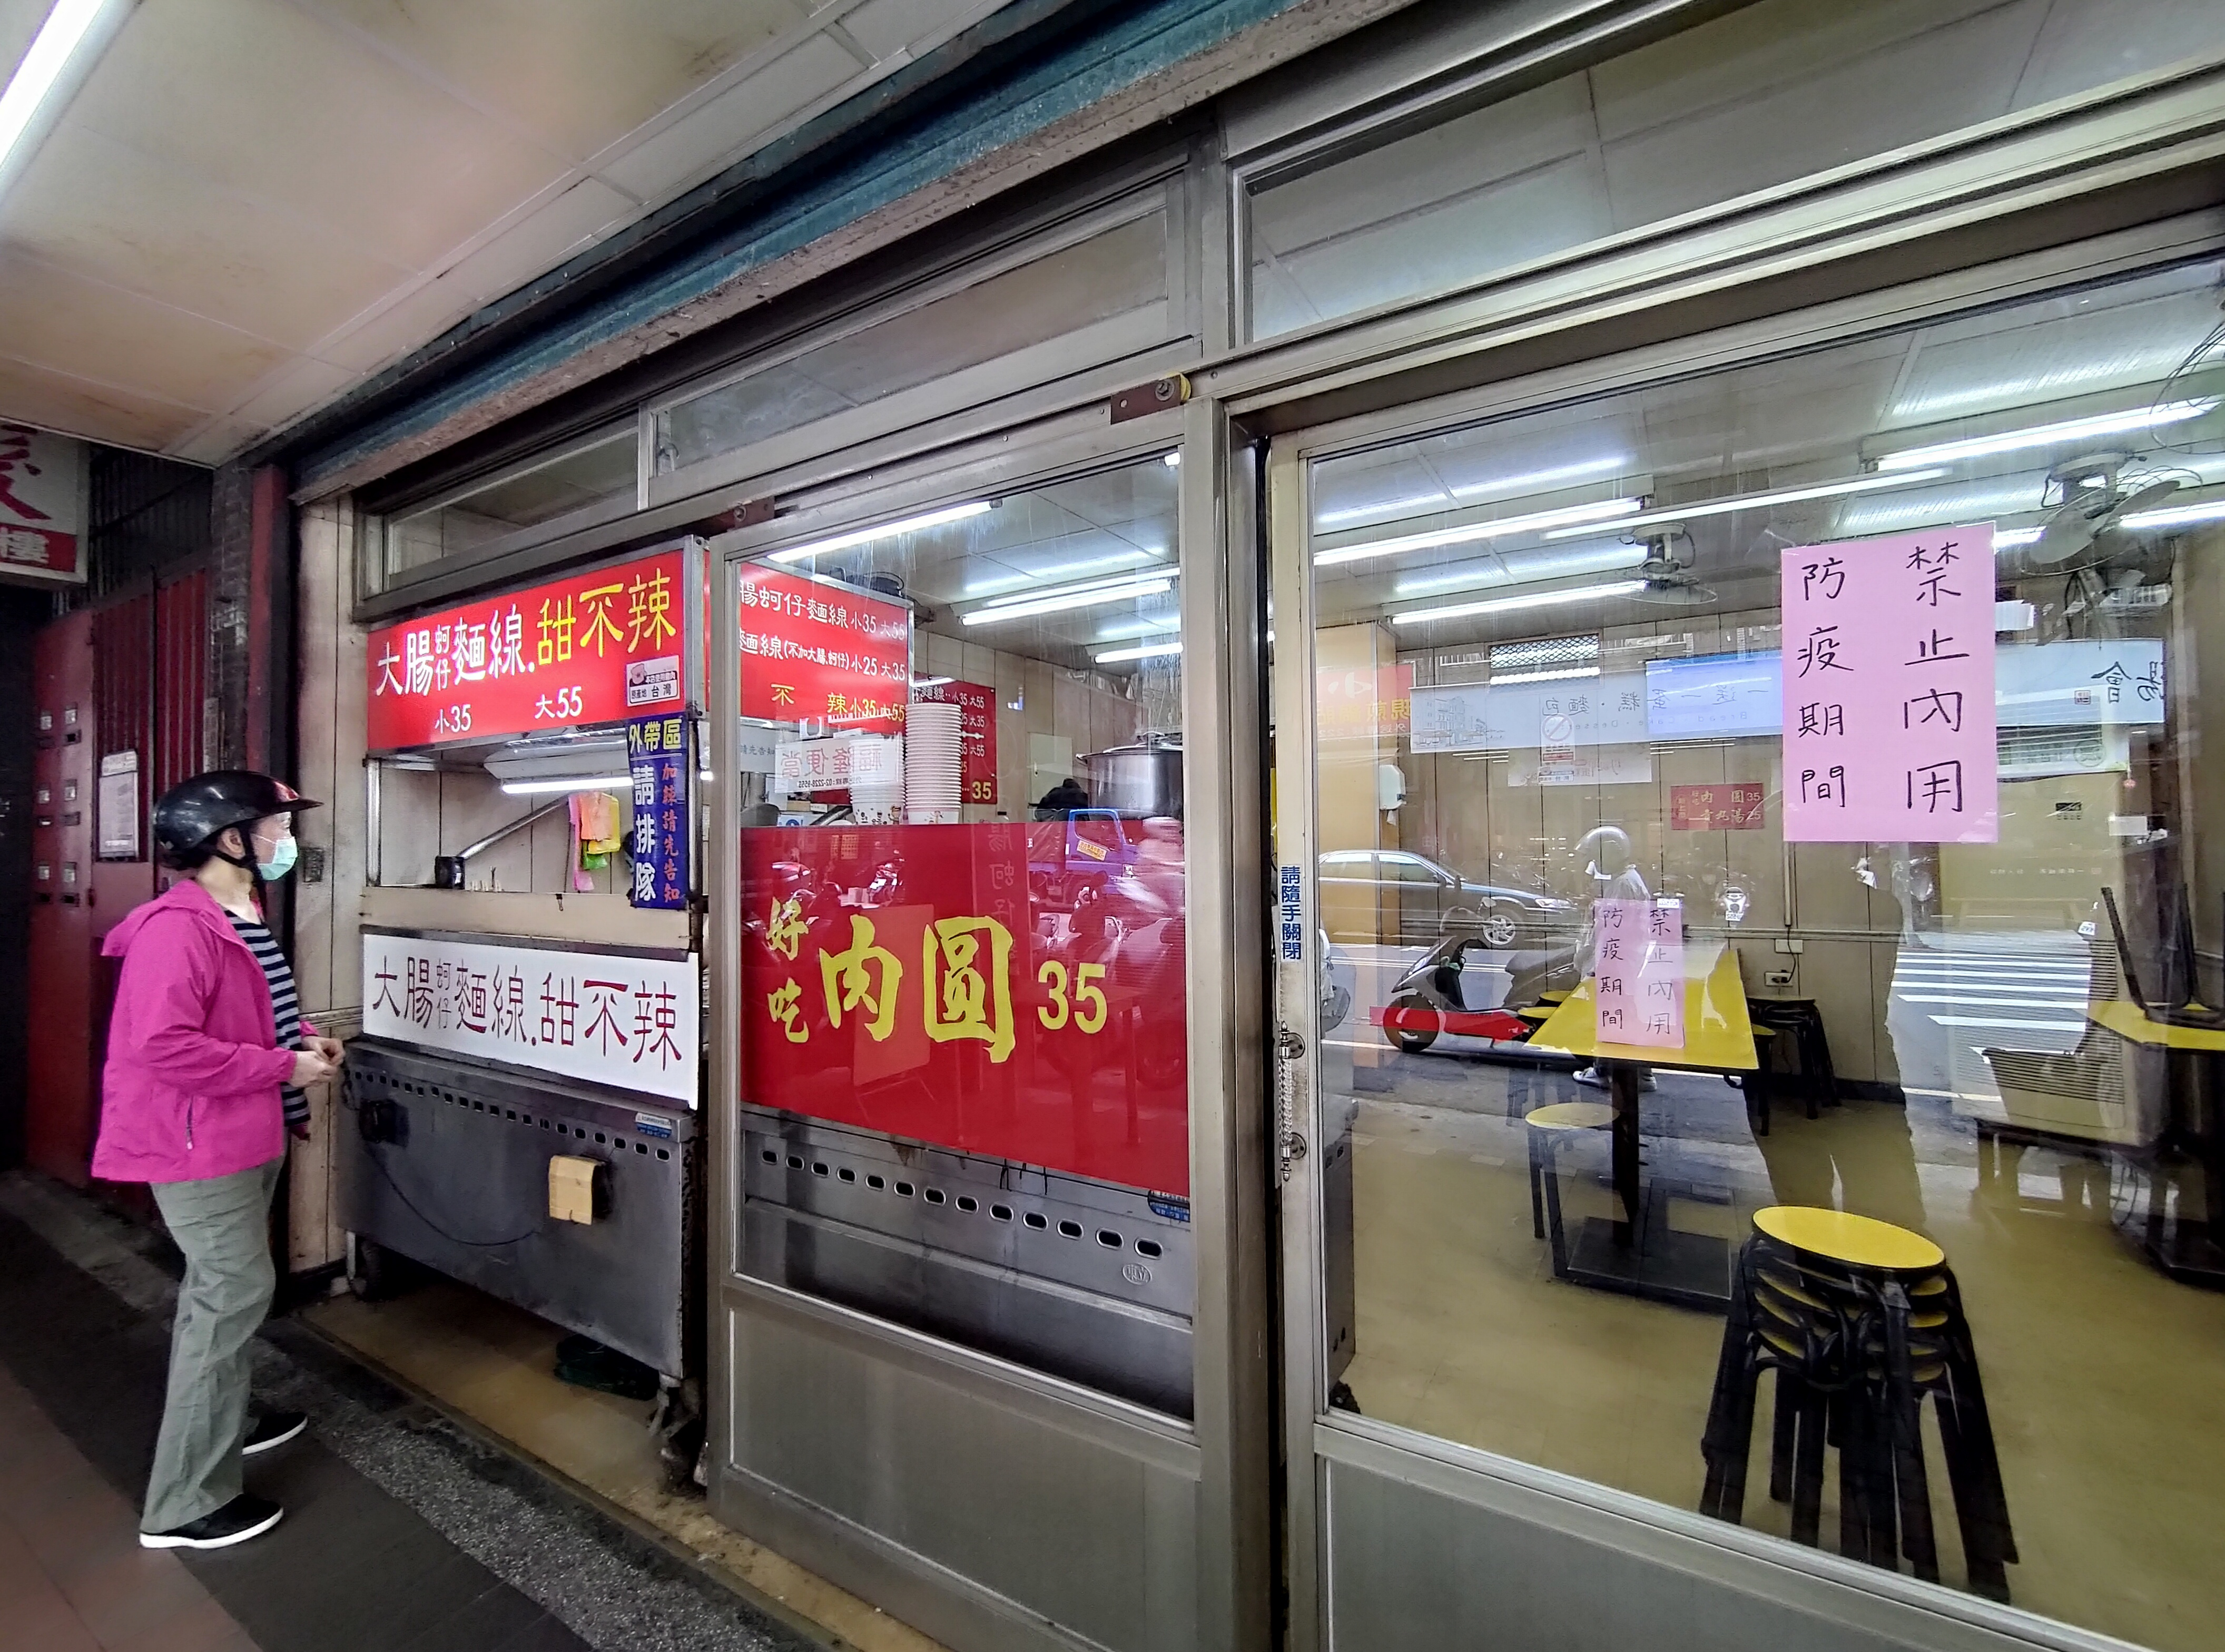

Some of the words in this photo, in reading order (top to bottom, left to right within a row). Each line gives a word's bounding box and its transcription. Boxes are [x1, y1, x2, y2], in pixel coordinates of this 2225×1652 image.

[851, 611, 877, 634] 小35
[880, 620, 905, 641] 大55
[851, 654, 878, 676] 小25
[881, 662, 905, 681] 大35
[1797, 557, 1854, 808] 防疫期間
[1905, 542, 1970, 813] 禁止內用
[435, 703, 471, 734] 小35
[534, 686, 583, 720] 大55
[969, 695, 985, 709] 大55
[628, 718, 682, 754] 外帶區
[969, 716, 985, 729] 大35
[970, 745, 985, 758] 大55
[972, 781, 992, 800] 35
[1747, 792, 1761, 802] 35
[633, 764, 656, 902] 請排隊
[662, 762, 680, 903] 加辣請先告知
[1281, 866, 1301, 960] 請隨手關閉
[765, 897, 809, 1044] 好吃
[1600, 908, 1623, 1029] 防疫期間
[1646, 909, 1673, 1035] 禁止內用
[819, 914, 1016, 1064] 肉圓
[1037, 960, 1108, 1035] 35
